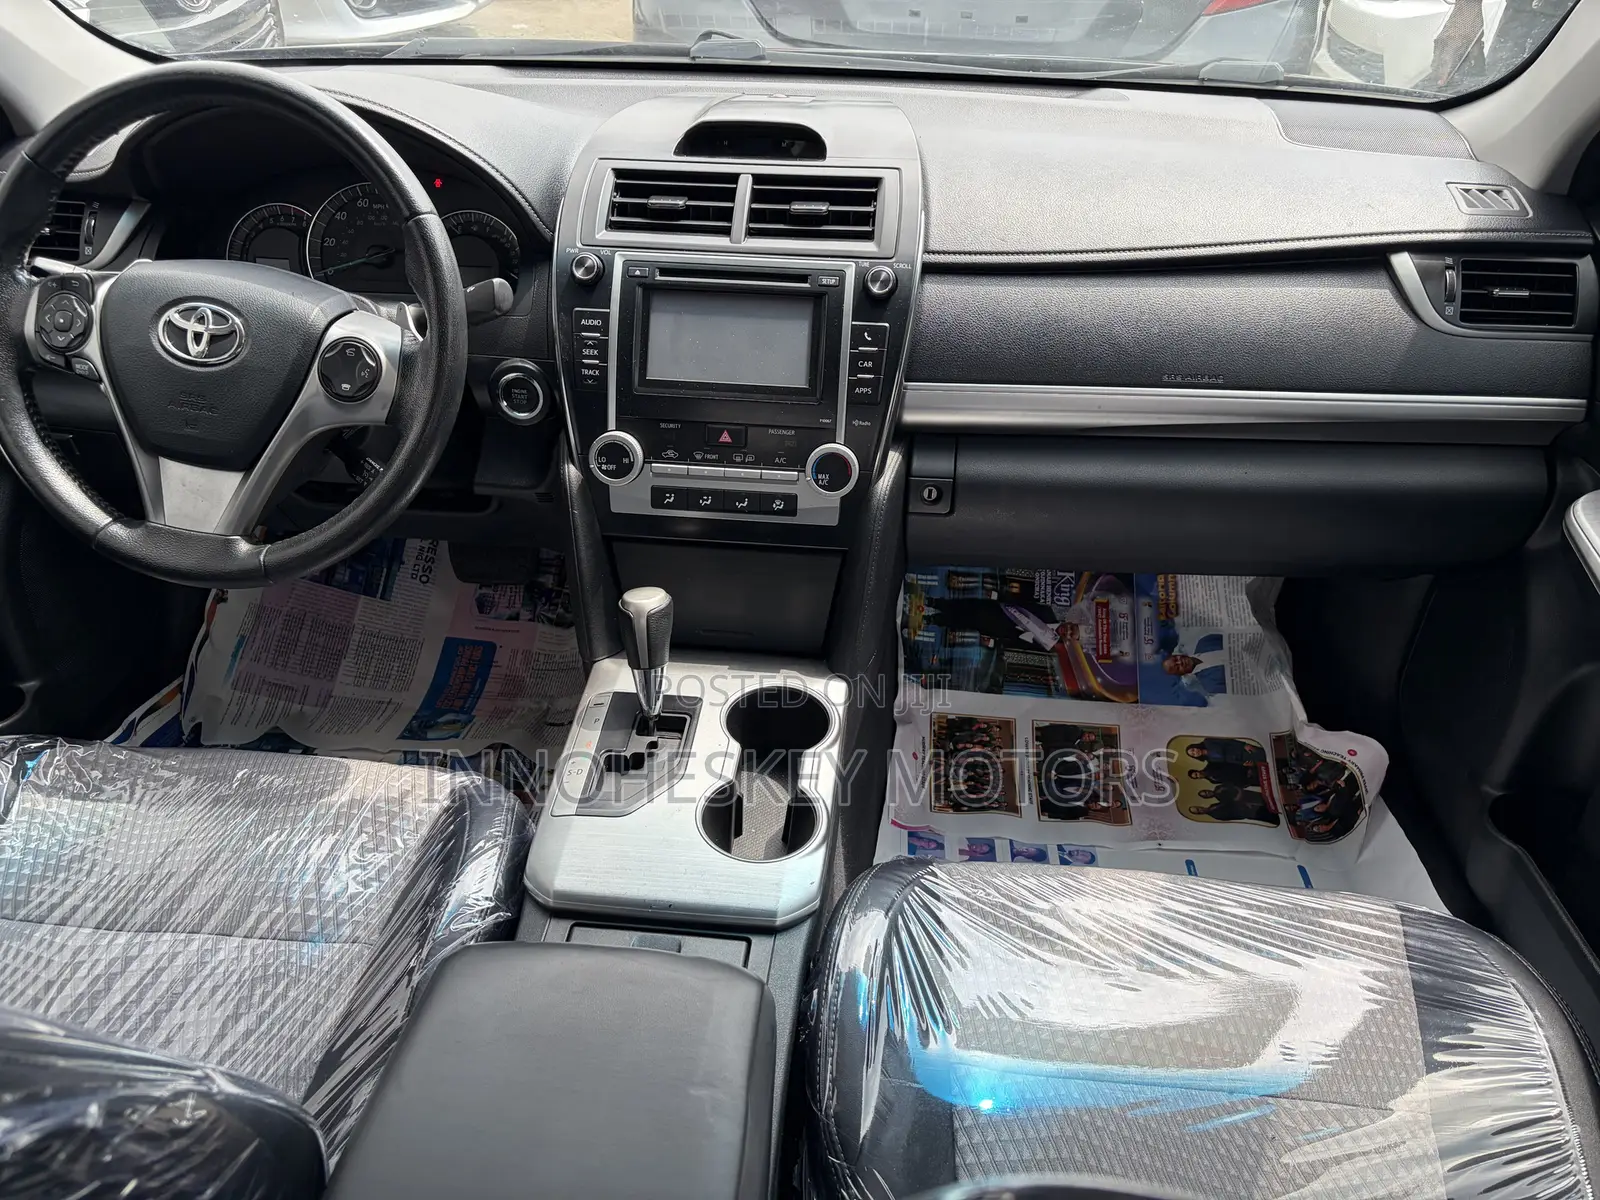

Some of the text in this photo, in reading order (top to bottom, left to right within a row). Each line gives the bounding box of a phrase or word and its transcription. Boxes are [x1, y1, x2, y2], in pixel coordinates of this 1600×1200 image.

[356, 198, 369, 208] 60
[334, 212, 348, 220] 40
[323, 238, 336, 246] 20
[411, 564, 420, 580] LTD
[1054, 570, 1076, 608] King
[1320, 749, 1347, 760] TEACHING
